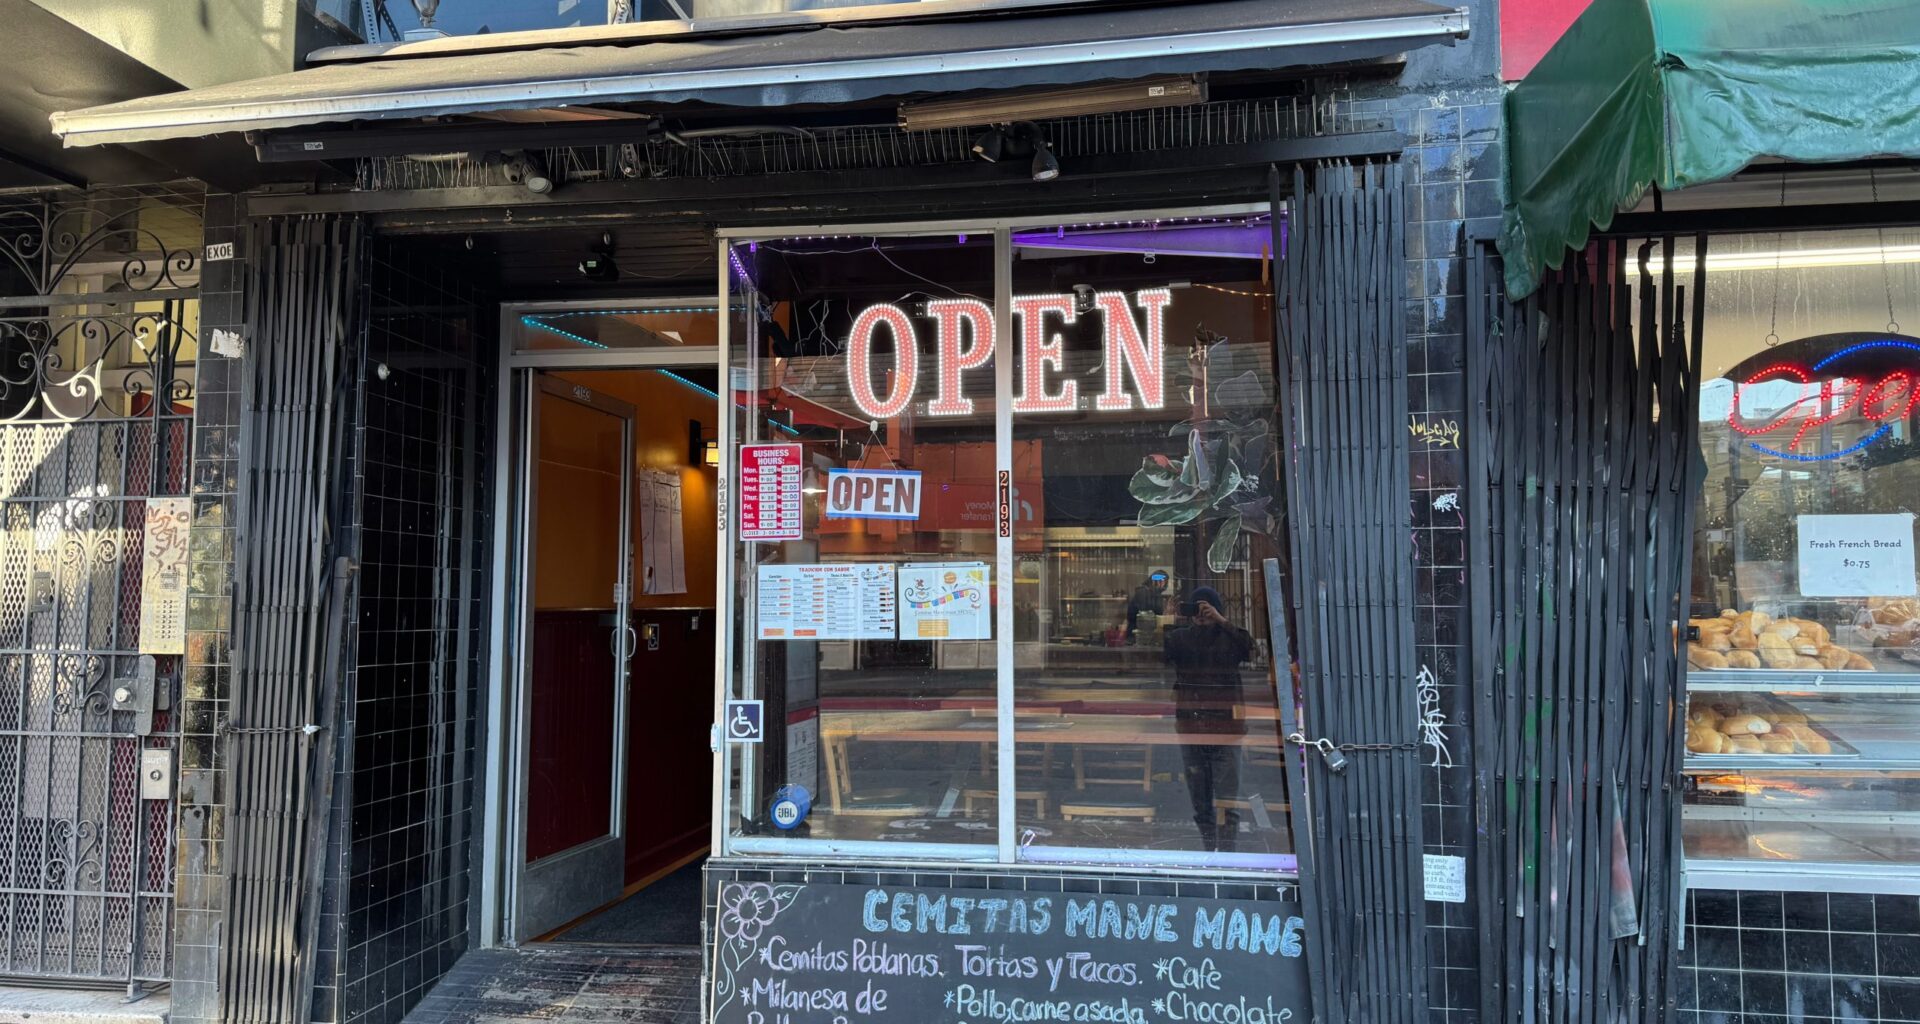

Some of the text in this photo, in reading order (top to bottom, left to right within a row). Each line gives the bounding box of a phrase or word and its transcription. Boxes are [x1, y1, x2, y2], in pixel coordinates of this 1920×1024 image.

[207, 244, 232, 259] EXOE
[847, 289, 1170, 418] OPEN
[753, 449, 789, 457] BUSINESS
[757, 457, 784, 465] HOURS:
[832, 475, 915, 513] OPEN
[1000, 471, 1008, 536] 2193
[1810, 539, 1902, 548] Fresh French Bread
[1843, 558, 1870, 568] $0.75
[863, 889, 1052, 935] CEMITAS
[955, 944, 1038, 979] Tortas
[1046, 956, 1063, 992] y
[855, 979, 888, 1015] de
